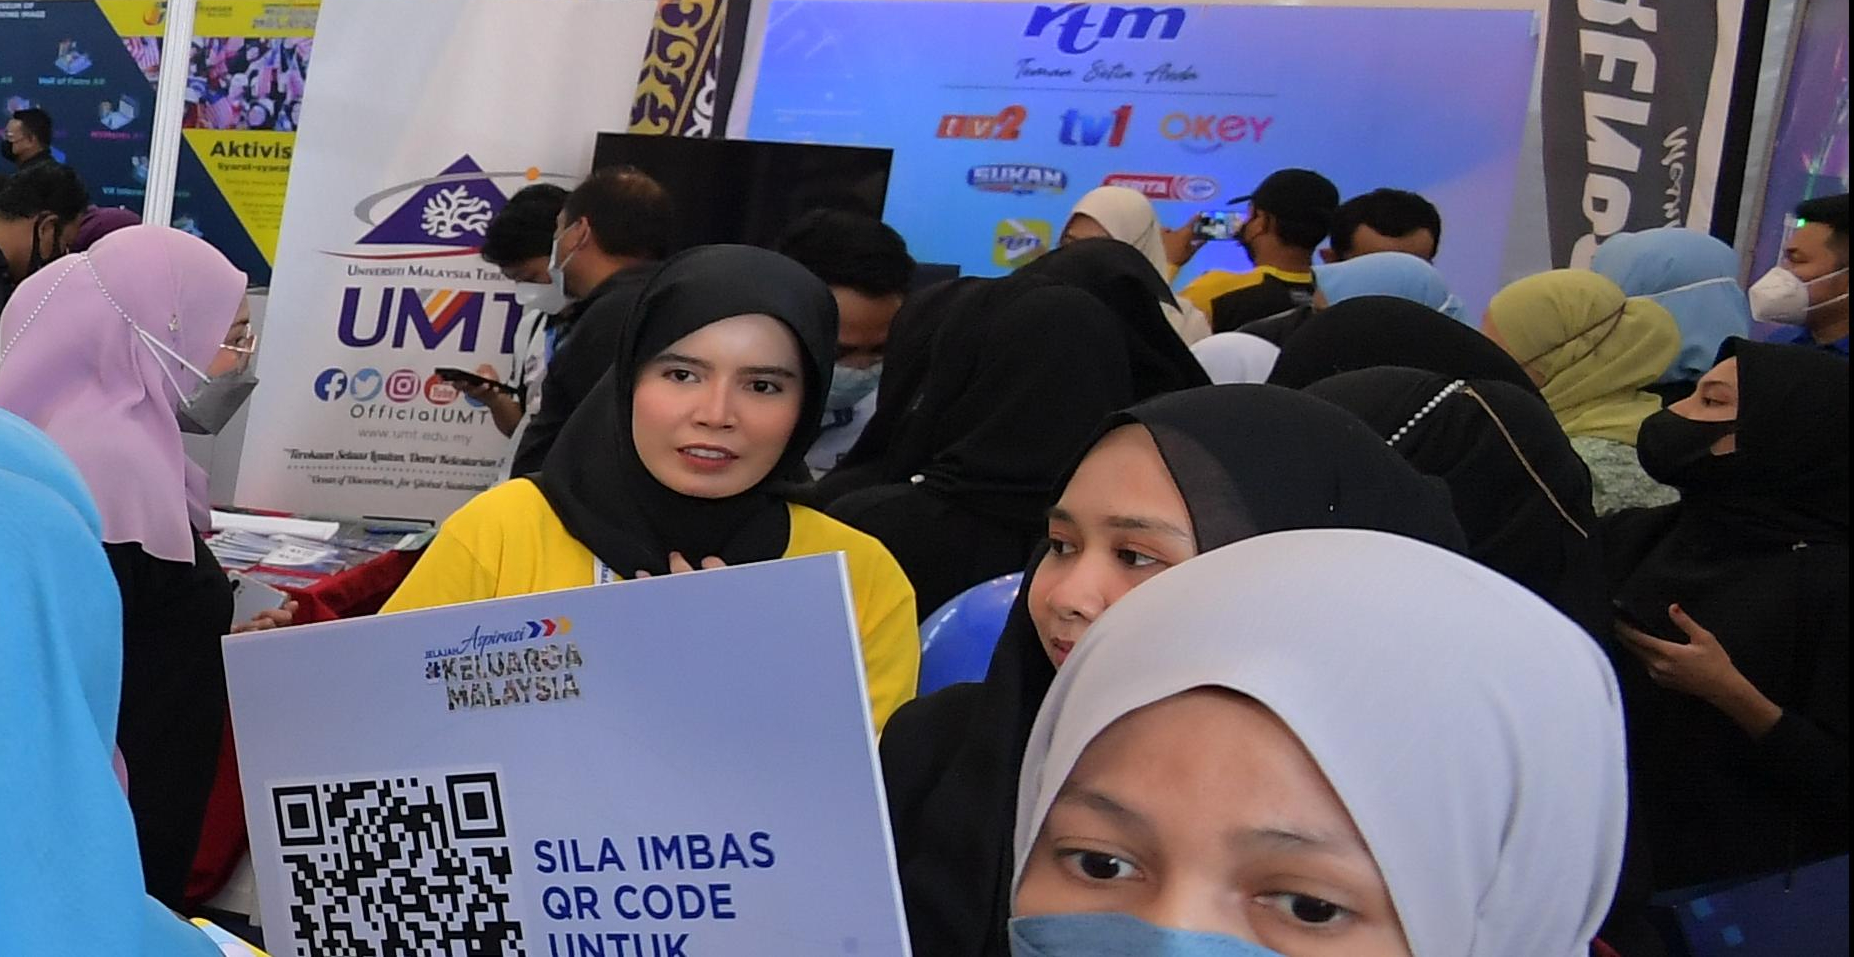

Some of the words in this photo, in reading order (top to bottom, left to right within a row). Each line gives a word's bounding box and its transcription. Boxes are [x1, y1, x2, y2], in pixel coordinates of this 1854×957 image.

[1023, 3, 1186, 55] rtm
[1059, 103, 1134, 147] tv1
[407, 265, 472, 279] MALAYSIA
[337, 286, 524, 355] UMT
[350, 403, 490, 425] OfficialUMT
[458, 624, 527, 656] Aspirasi
[425, 642, 583, 684] #KELUARGA
[446, 672, 581, 711] MALAYSIA
[534, 837, 627, 874] SILA
[637, 831, 776, 871] IMBAS
[542, 885, 601, 920] QR
[613, 884, 736, 920] CODE
[548, 932, 690, 957] UNTUK
